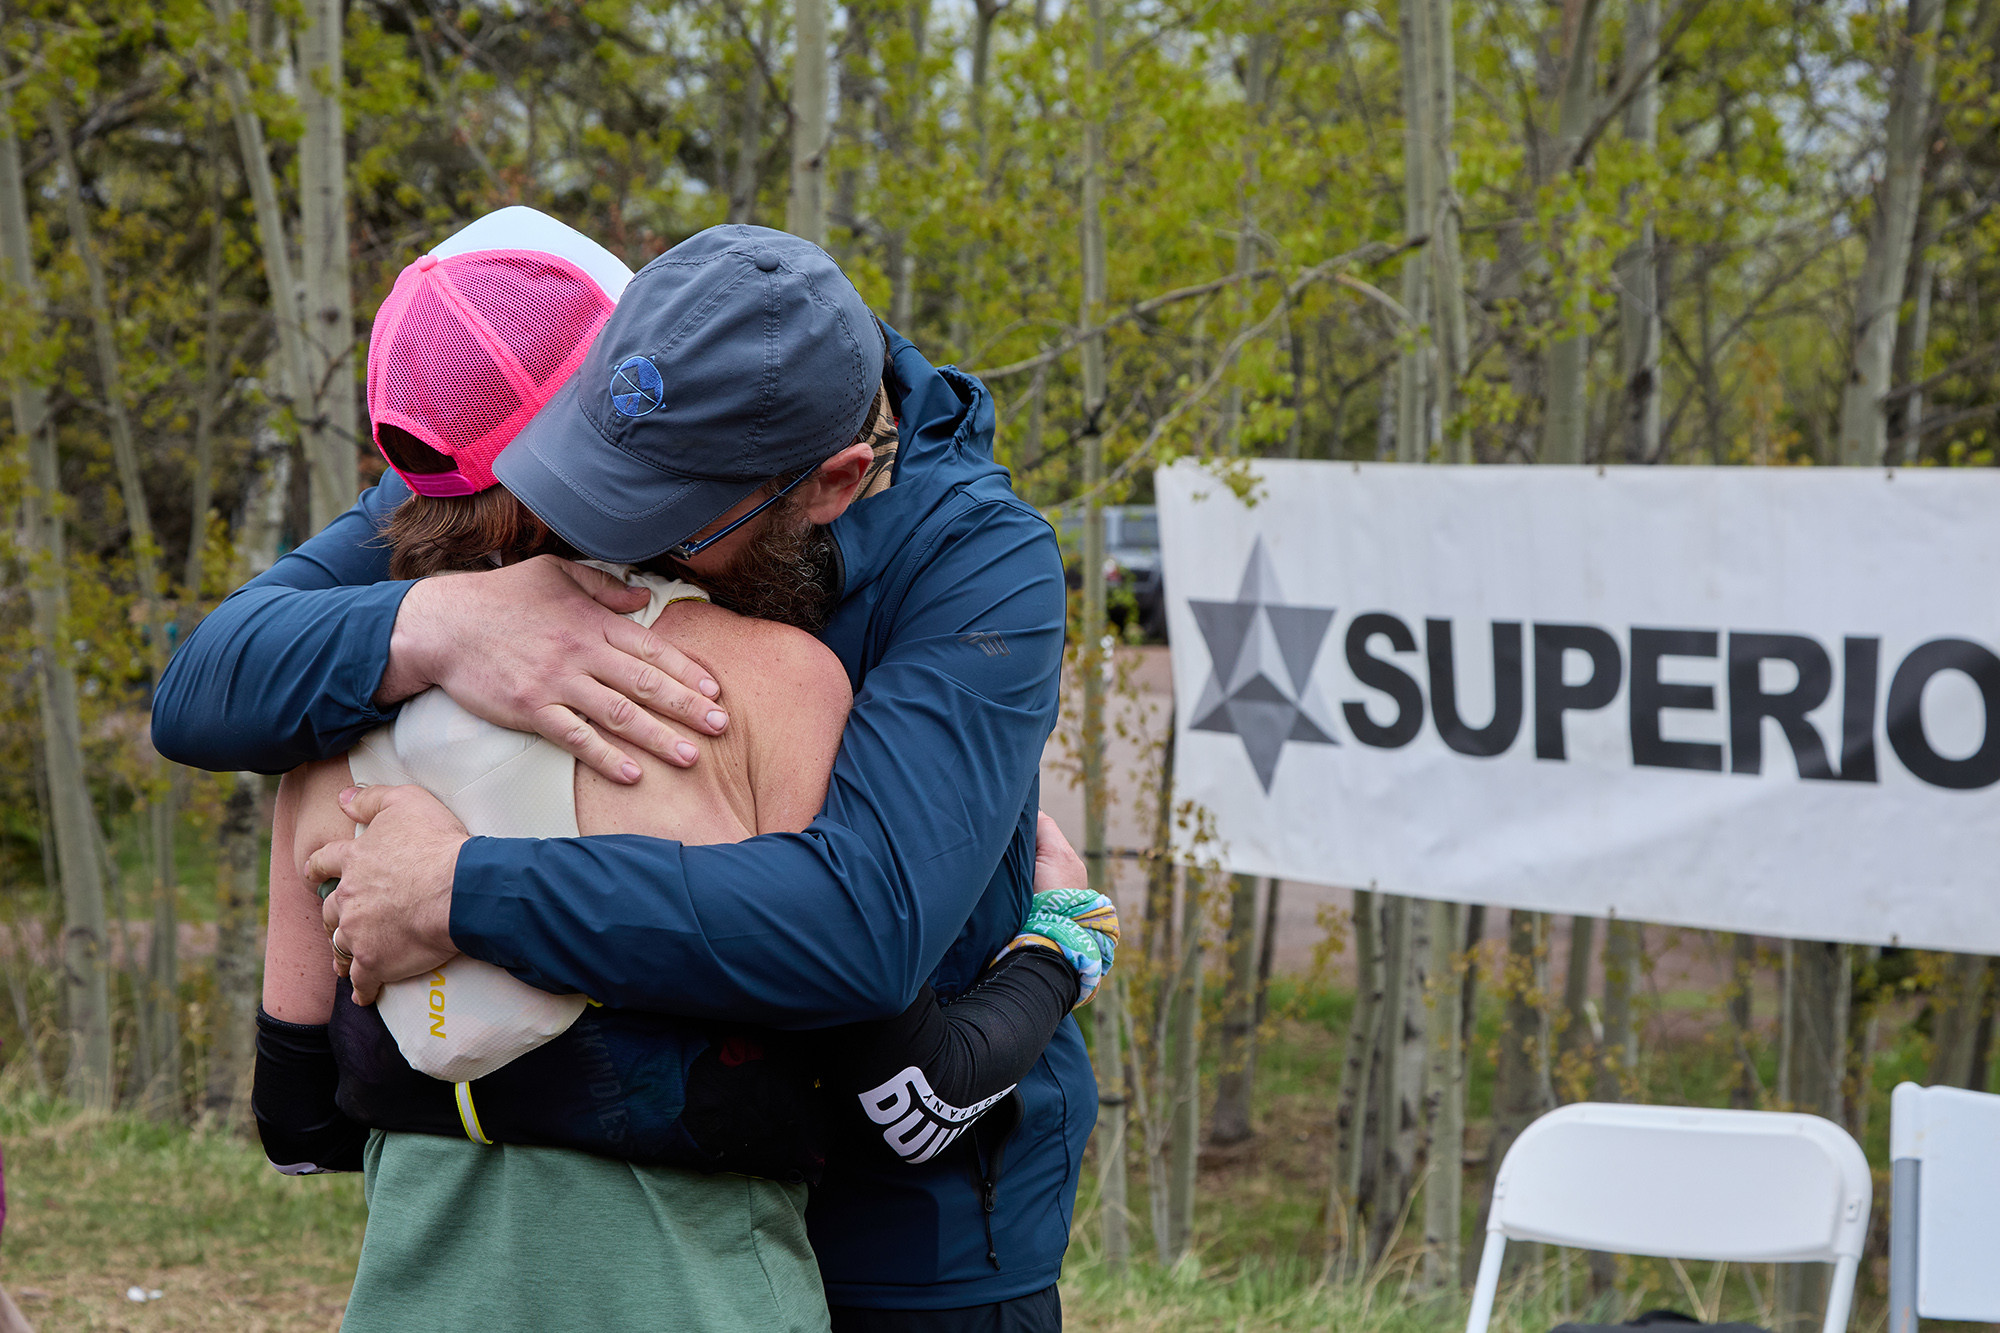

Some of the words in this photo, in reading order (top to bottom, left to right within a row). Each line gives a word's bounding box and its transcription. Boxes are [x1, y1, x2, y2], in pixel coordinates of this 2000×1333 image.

[1342, 611, 2000, 790] SUPERIO
[428, 963, 447, 1039] NOV
[923, 1092, 1004, 1119] COMPANY
